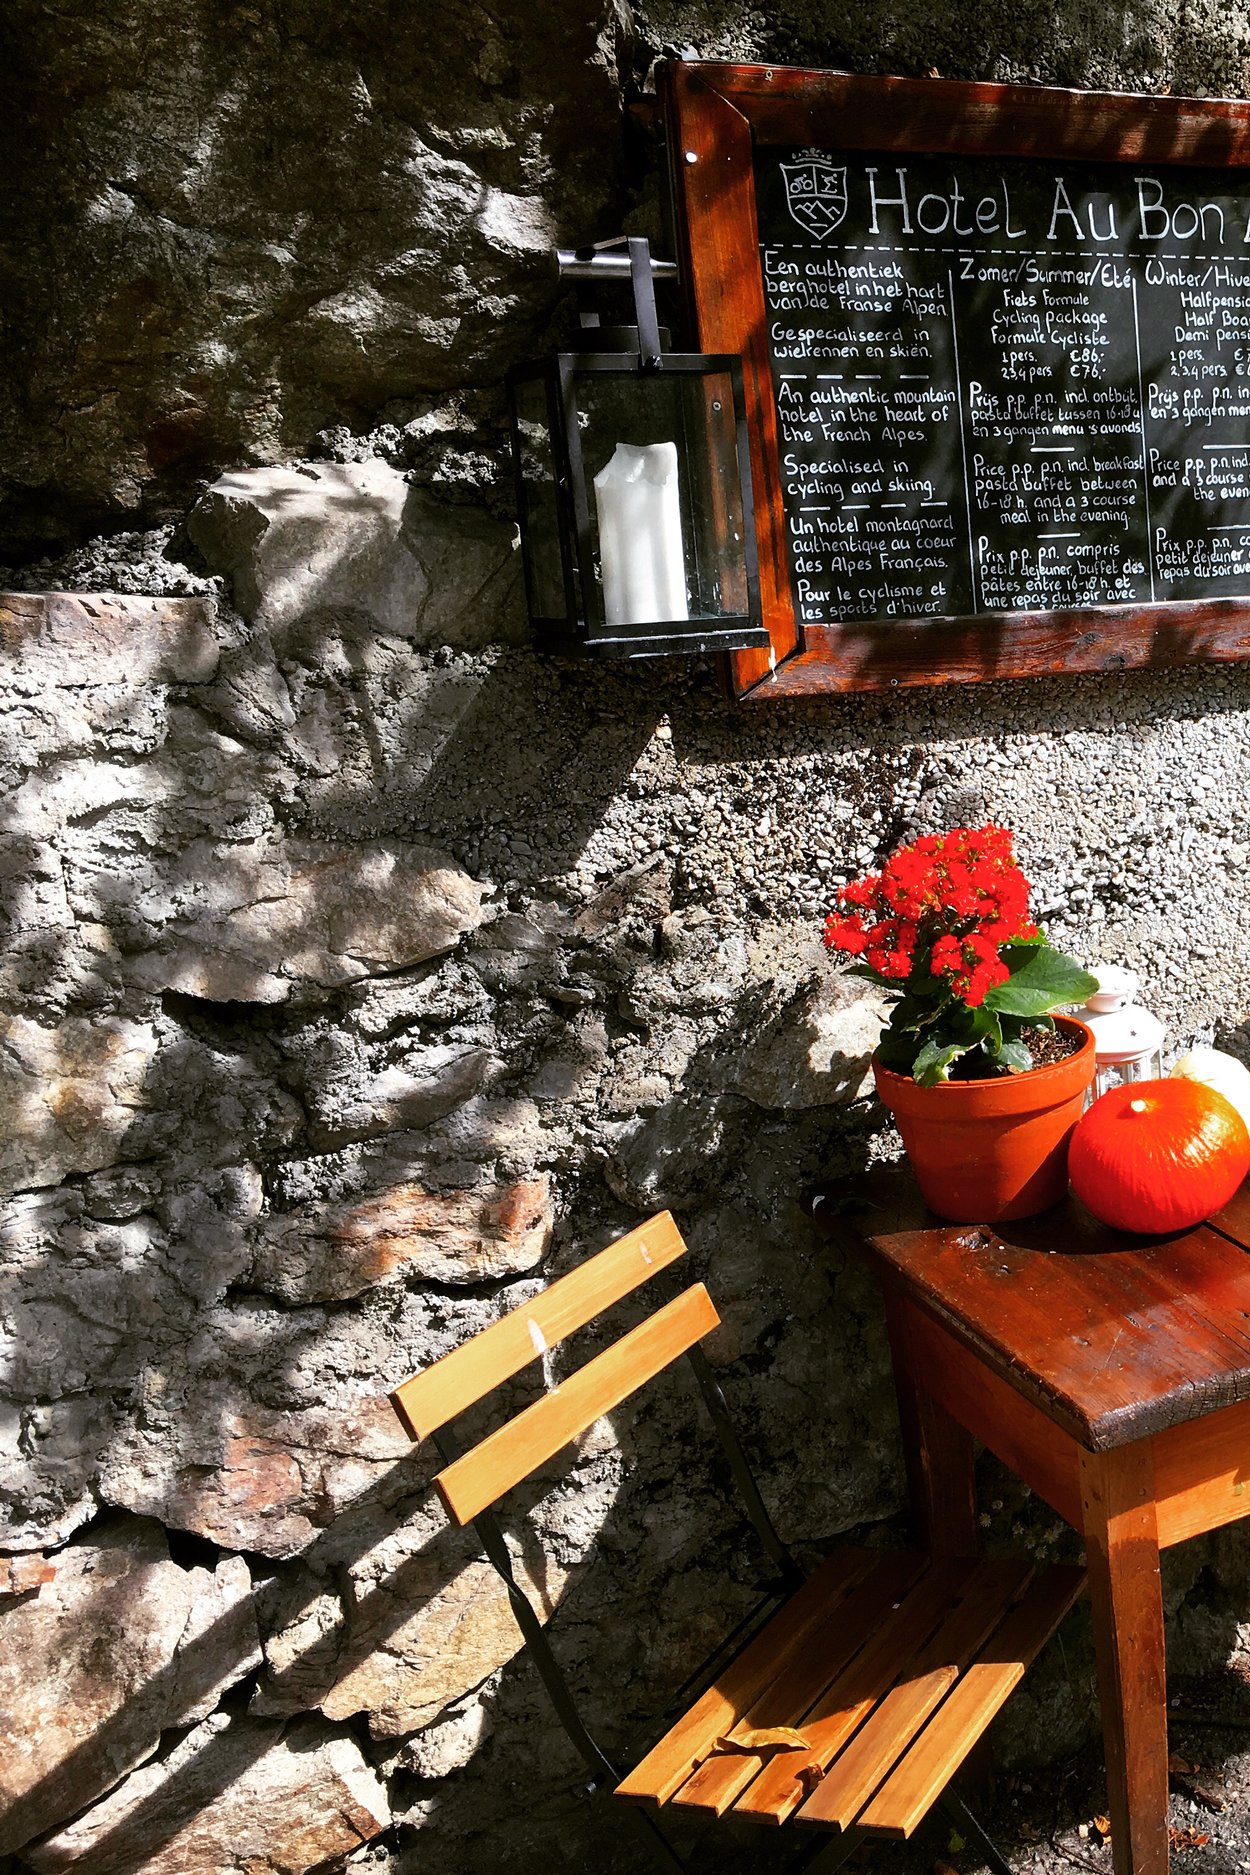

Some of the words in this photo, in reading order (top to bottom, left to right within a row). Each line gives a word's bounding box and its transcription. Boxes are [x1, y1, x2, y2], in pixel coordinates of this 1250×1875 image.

[865, 168, 1027, 238] Hotel
[1047, 177, 1119, 241] Au
[1134, 178, 1225, 244] Bon
[765, 251, 799, 275] Een
[805, 259, 904, 278] authentiek
[765, 275, 850, 306] berghotel
[855, 283, 871, 295] in
[873, 281, 903, 297] het
[906, 283, 945, 298] hart
[1003, 289, 1036, 307] Fiets
[1042, 289, 1089, 306] Formule
[769, 297, 800, 310] van
[810, 295, 829, 309] de
[839, 296, 892, 312] Franse
[993, 309, 1040, 333] Cycling
[1045, 309, 1108, 333] package
[1185, 311, 1214, 327] Half
[771, 322, 903, 345] Gespecialiseerd
[914, 329, 929, 341] in
[991, 326, 1046, 344] Formule
[1050, 330, 1110, 350] Cycliste
[1175, 326, 1209, 342] Demi
[774, 342, 859, 358] wielrennen
[866, 347, 883, 358] en
[890, 343, 932, 358] skiën.
[778, 382, 803, 403] An
[810, 386, 889, 404] authentic
[894, 387, 955, 404] mountain
[778, 405, 823, 422] hotel
[830, 409, 845, 422] in
[850, 408, 878, 421] the
[885, 405, 926, 422] heart
[932, 405, 949, 420] of
[1183, 406, 1225, 426] gangen
[784, 425, 813, 442] the
[821, 423, 870, 442] French
[882, 426, 928, 447] Alpes.
[973, 426, 988, 437] en
[993, 426, 1001, 436] 3
[1003, 424, 1049, 445] gangen
[1052, 423, 1084, 435] menu
[784, 453, 884, 481] Specialised
[893, 460, 908, 472] in
[973, 453, 1006, 477] Price
[1012, 464, 1035, 482] p.p.
[1041, 462, 1064, 482] p.n.
[1093, 454, 1144, 472] breakfast
[1149, 448, 1180, 473] Price
[1185, 458, 1206, 478] p.p.
[1211, 460, 1230, 478] p.n.
[787, 479, 845, 502] cycling
[851, 480, 882, 494] and
[888, 477, 935, 500] skiing.
[975, 477, 1018, 496] pasta
[1022, 477, 1072, 492] buffet
[1080, 476, 1137, 491] between
[1153, 473, 1176, 487] and
[1182, 476, 1190, 486] a
[1197, 476, 1203, 485] 3
[1206, 473, 1244, 485] course
[1034, 495, 1061, 508] and
[1066, 498, 1076, 507] a
[1081, 497, 1089, 506] 3
[1093, 495, 1136, 506] course
[1194, 488, 1216, 501] the
[790, 517, 813, 535] Un
[817, 516, 859, 533] hotel
[866, 515, 953, 536] montagnard
[1000, 509, 1030, 525] meal
[1037, 512, 1049, 522] in
[1054, 509, 1076, 523] the
[1080, 511, 1130, 530] evening.
[792, 536, 887, 555] authentique
[891, 539, 910, 549] au
[916, 537, 956, 548] coeur
[978, 536, 1004, 564] Prix
[1067, 544, 1120, 559] compris
[1156, 527, 1180, 552] Prix
[795, 557, 823, 573] des
[831, 557, 872, 576] Alpes
[880, 553, 949, 571] Français.
[1156, 552, 1188, 569] petit
[1193, 549, 1244, 566] dejeuner
[1159, 567, 1190, 584] repas
[797, 578, 830, 602] Pour
[837, 586, 851, 600] le
[859, 583, 923, 603] cyclisme
[931, 581, 947, 595] et
[981, 577, 1020, 599] pâtes
[1026, 578, 1062, 592] entre
[1115, 575, 1131, 588] et
[984, 596, 1008, 608] une
[1012, 593, 1048, 610] repas
[1052, 592, 1070, 603] du
[1075, 590, 1099, 602] soir
[1107, 588, 1136, 599] avec
[801, 605, 823, 620] les
[830, 602, 877, 620] sports
